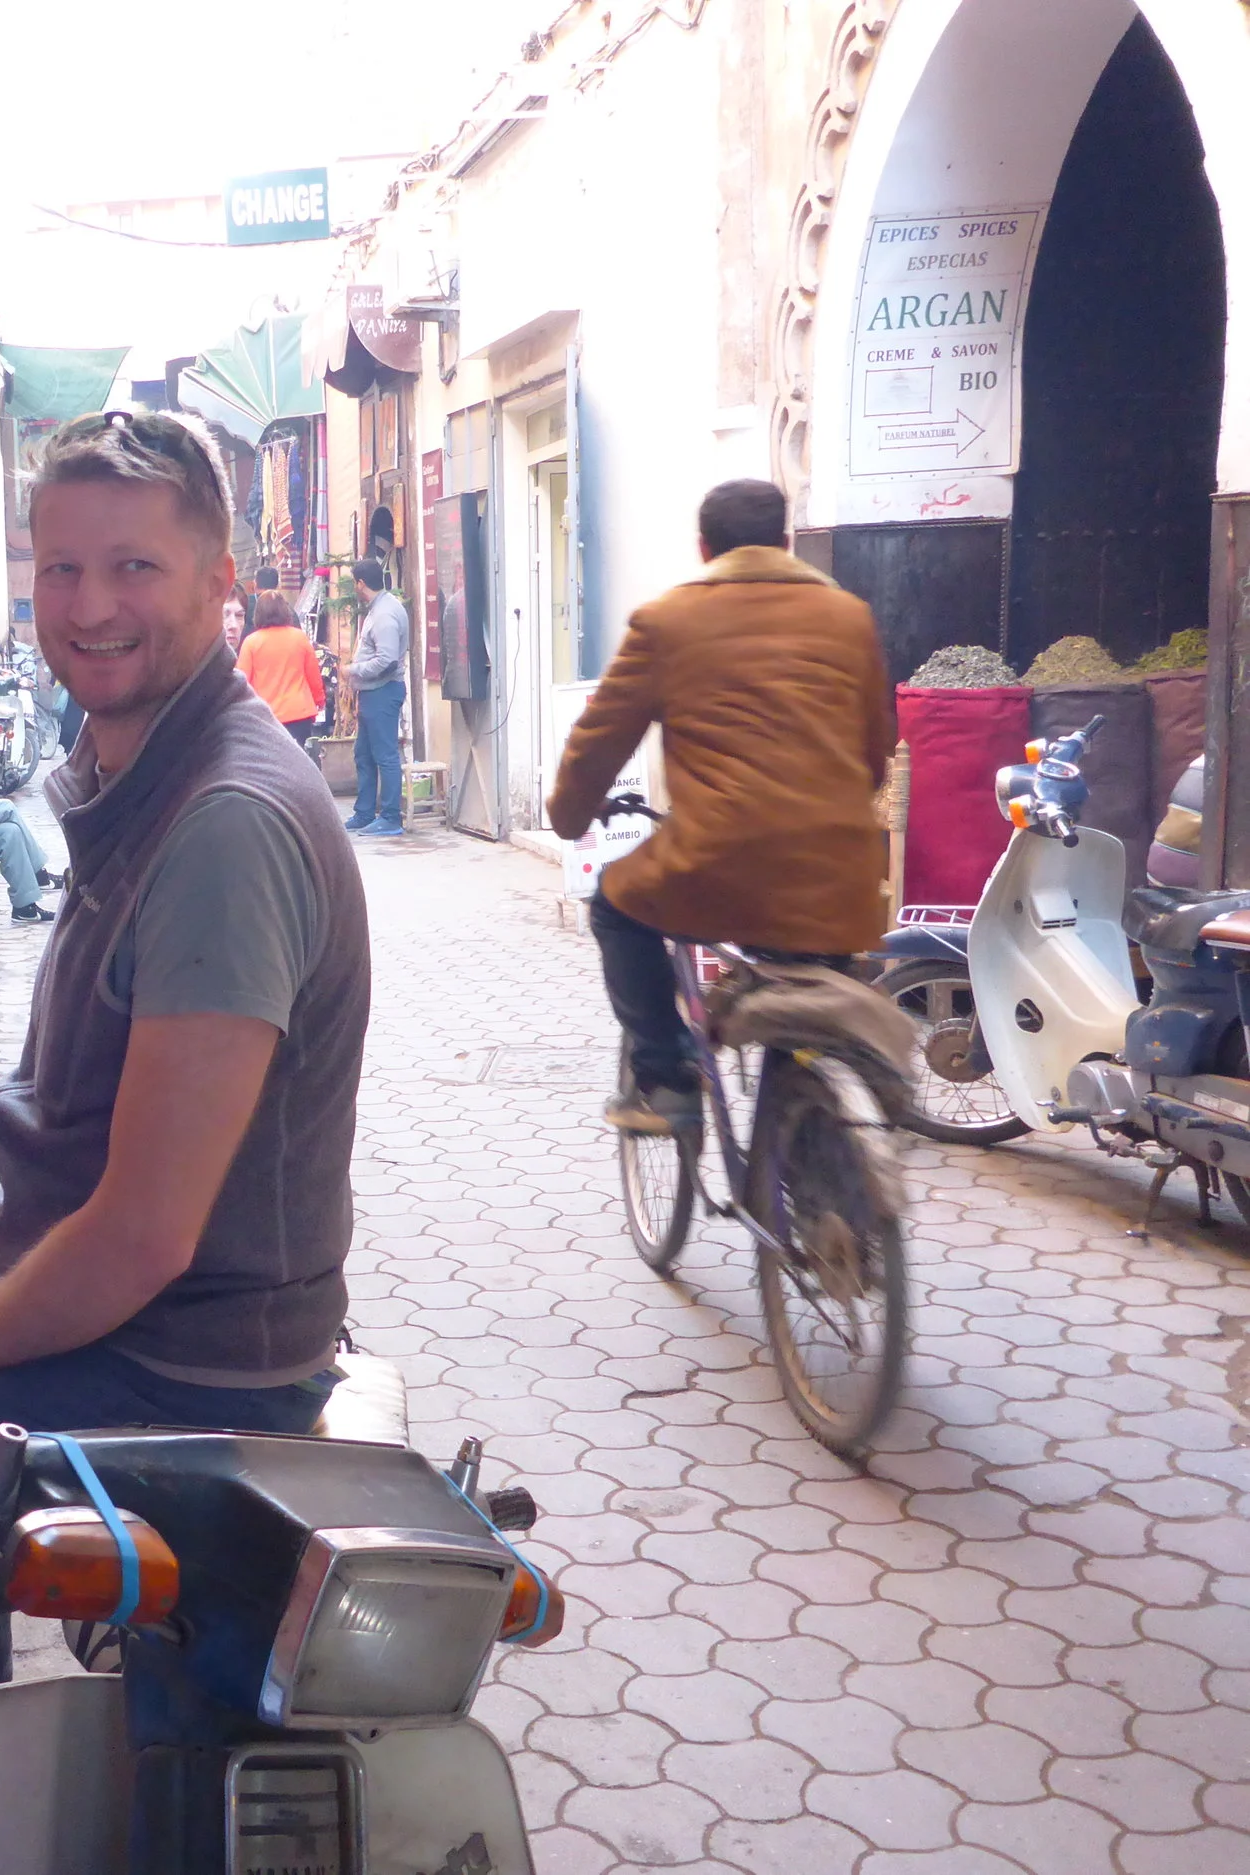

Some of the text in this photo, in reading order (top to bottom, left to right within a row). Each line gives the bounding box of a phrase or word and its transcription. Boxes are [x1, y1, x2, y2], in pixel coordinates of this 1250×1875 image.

[231, 183, 325, 227] CHANGE
[878, 220, 1019, 243] EPICES SPICES
[907, 251, 989, 271] ESPECIAS
[351, 291, 383, 308] GALE
[867, 289, 1009, 331] ARGAN
[867, 342, 998, 363] CREME & SAVON
[959, 370, 998, 392] BIO
[884, 428, 956, 441] PARFUM NATUREL
[612, 777, 641, 788] ANGE
[605, 830, 641, 841] CAMBIO
